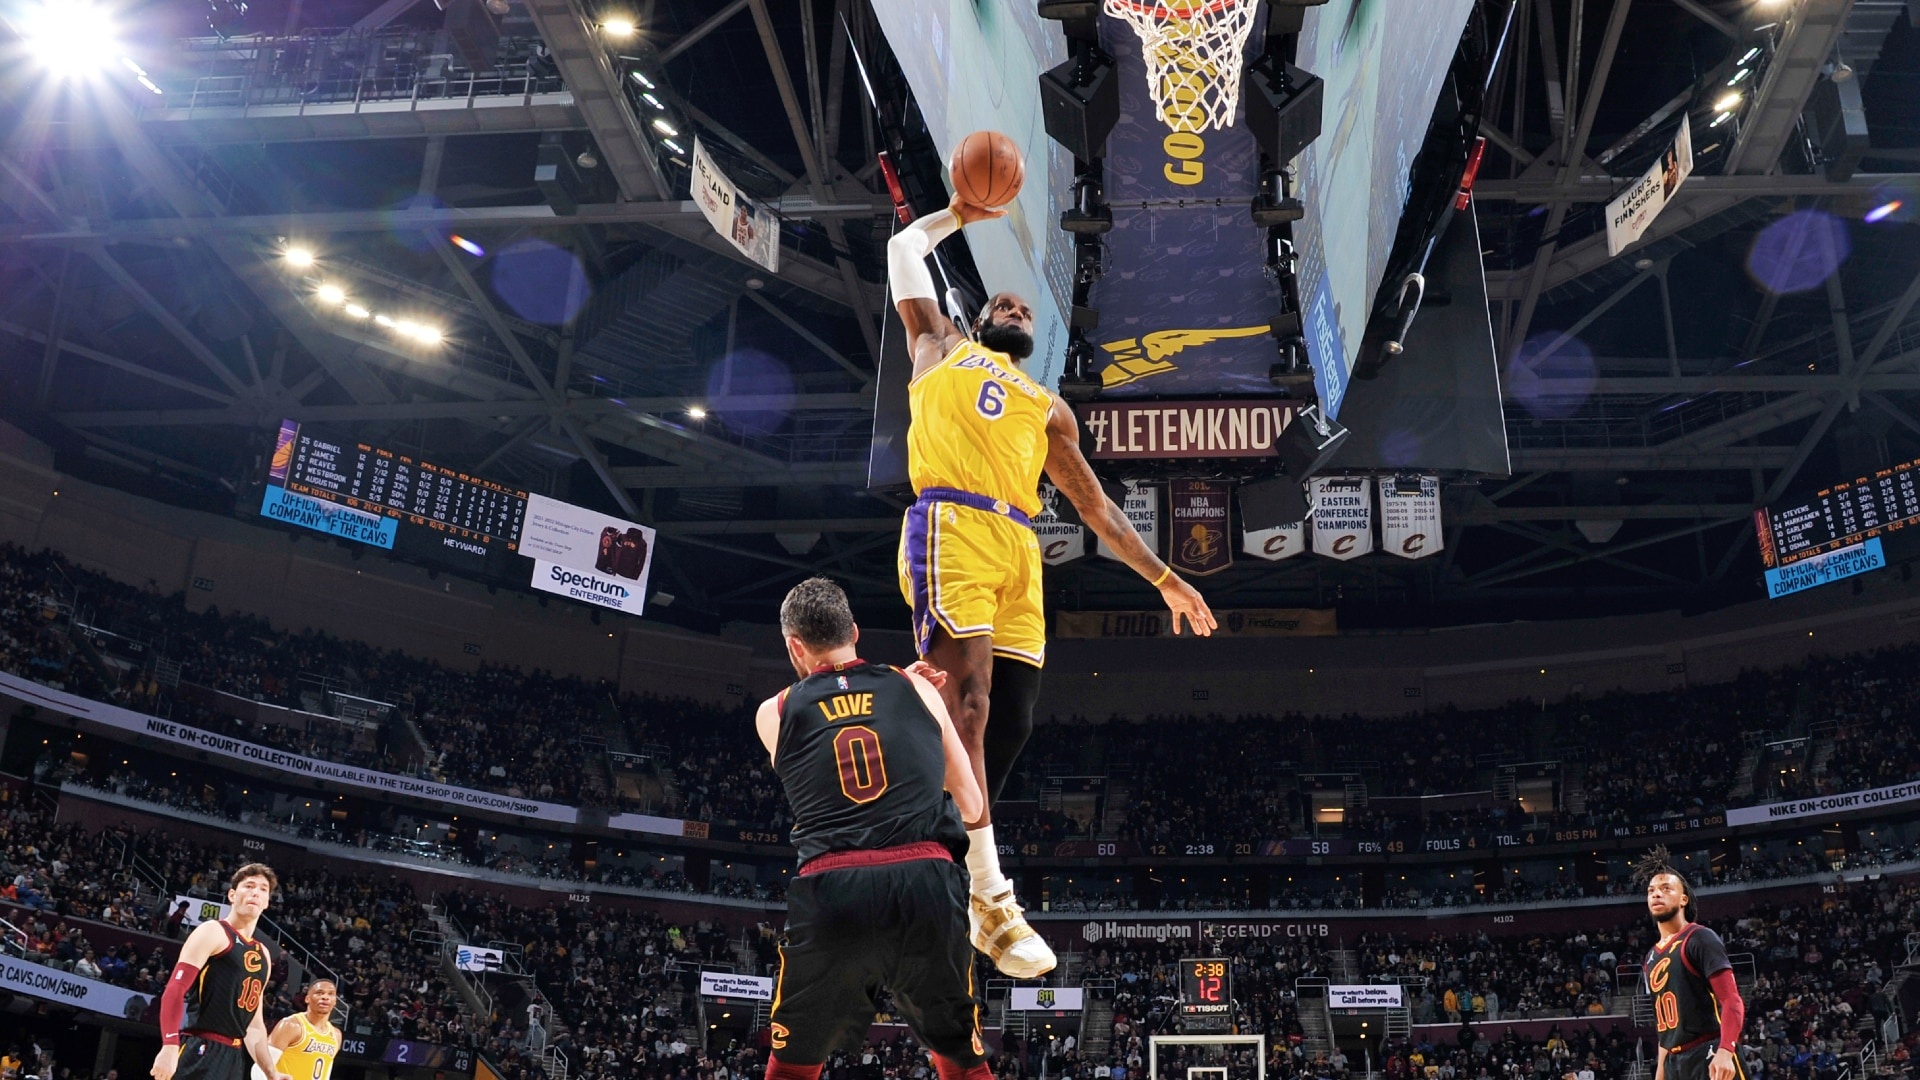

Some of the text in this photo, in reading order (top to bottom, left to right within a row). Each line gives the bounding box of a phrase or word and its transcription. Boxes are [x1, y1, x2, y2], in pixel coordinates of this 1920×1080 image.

[1622, 176, 1651, 208] LAURI'S
[1314, 290, 1342, 407] FirstEnergy
[951, 354, 1036, 397] LAKERS
[975, 379, 1008, 421] 6
[313, 440, 342, 454] GABRIEL
[311, 449, 335, 461] JAMES
[309, 457, 336, 471] REAVES
[307, 466, 347, 483] WESTBROOK
[305, 475, 339, 490] AUGUSTIN
[290, 482, 308, 493] TEAM
[311, 487, 337, 501] TOTALS
[1125, 499, 1147, 509] TERN
[1190, 496, 1209, 507] NBA
[1321, 496, 1361, 507] EASTERN
[1174, 507, 1226, 518] CHAMPIONS
[1314, 508, 1369, 518] CONFERENCE
[1782, 504, 1809, 519] STEVENS
[1784, 510, 1820, 527] MARKKANEN
[268, 502, 321, 527] COMPANY
[340, 521, 358, 538] THE
[360, 527, 388, 545] CAVS
[1317, 520, 1368, 530] CHAMPIONS
[1786, 521, 1814, 535] GARLAND
[1787, 532, 1803, 543] LOVE
[1789, 539, 1811, 551] OSMAN
[1781, 546, 1822, 564] TEAM TOTALS
[550, 565, 625, 599] Spectrum
[1773, 572, 1817, 595] COMPANY
[1834, 563, 1852, 579] THE
[1853, 554, 1879, 571] CAVS
[569, 587, 623, 608] ENTERPRISE
[818, 693, 874, 722] LOVE
[146, 719, 539, 814] NIKE ON-COURT COLLECTION AVAILABLE IN THE TEAM SHOP OR CAVS.COM/SHOP
[833, 725, 888, 805] 0
[1769, 803, 1797, 817] NIKE
[1799, 795, 1860, 813] ON-COURT
[1614, 827, 1630, 837] MIA
[1635, 826, 1647, 835] 32
[1652, 823, 1668, 833] PHI
[242, 839, 265, 851] M124
[1358, 842, 1382, 853] FG%
[1387, 841, 1404, 853] 49
[1426, 838, 1460, 851] FOULS
[1467, 837, 1476, 849] 4
[1496, 835, 1521, 847] TOL:
[1526, 833, 1534, 845] 4
[1582, 828, 1597, 840] PM
[998, 844, 1038, 856] G% 49
[1097, 843, 1116, 857] 60
[1185, 844, 1214, 855] 2:38
[1312, 841, 1330, 854] 58
[568, 893, 591, 903] M125
[201, 902, 220, 920] 811
[1493, 914, 1515, 925] M102
[1105, 920, 1192, 943] Huntington
[1194, 963, 1224, 978] 2:38
[5, 968, 88, 999] CAVS.COM/SHOP
[703, 976, 760, 987] Know what's below.
[1200, 977, 1221, 1001] 12
[713, 983, 728, 993] Call
[728, 986, 747, 994] before
[748, 988, 759, 996] you
[1038, 990, 1054, 1002] 811
[1365, 988, 1388, 996] below.
[1341, 996, 1357, 1004] Call
[1196, 1004, 1229, 1013] TISSOT
[1655, 991, 1679, 1032] 10
[302, 1037, 336, 1057] LAKERS
[397, 1044, 409, 1063] 2
[312, 1057, 324, 1080] 0
[454, 1059, 468, 1071] 49
